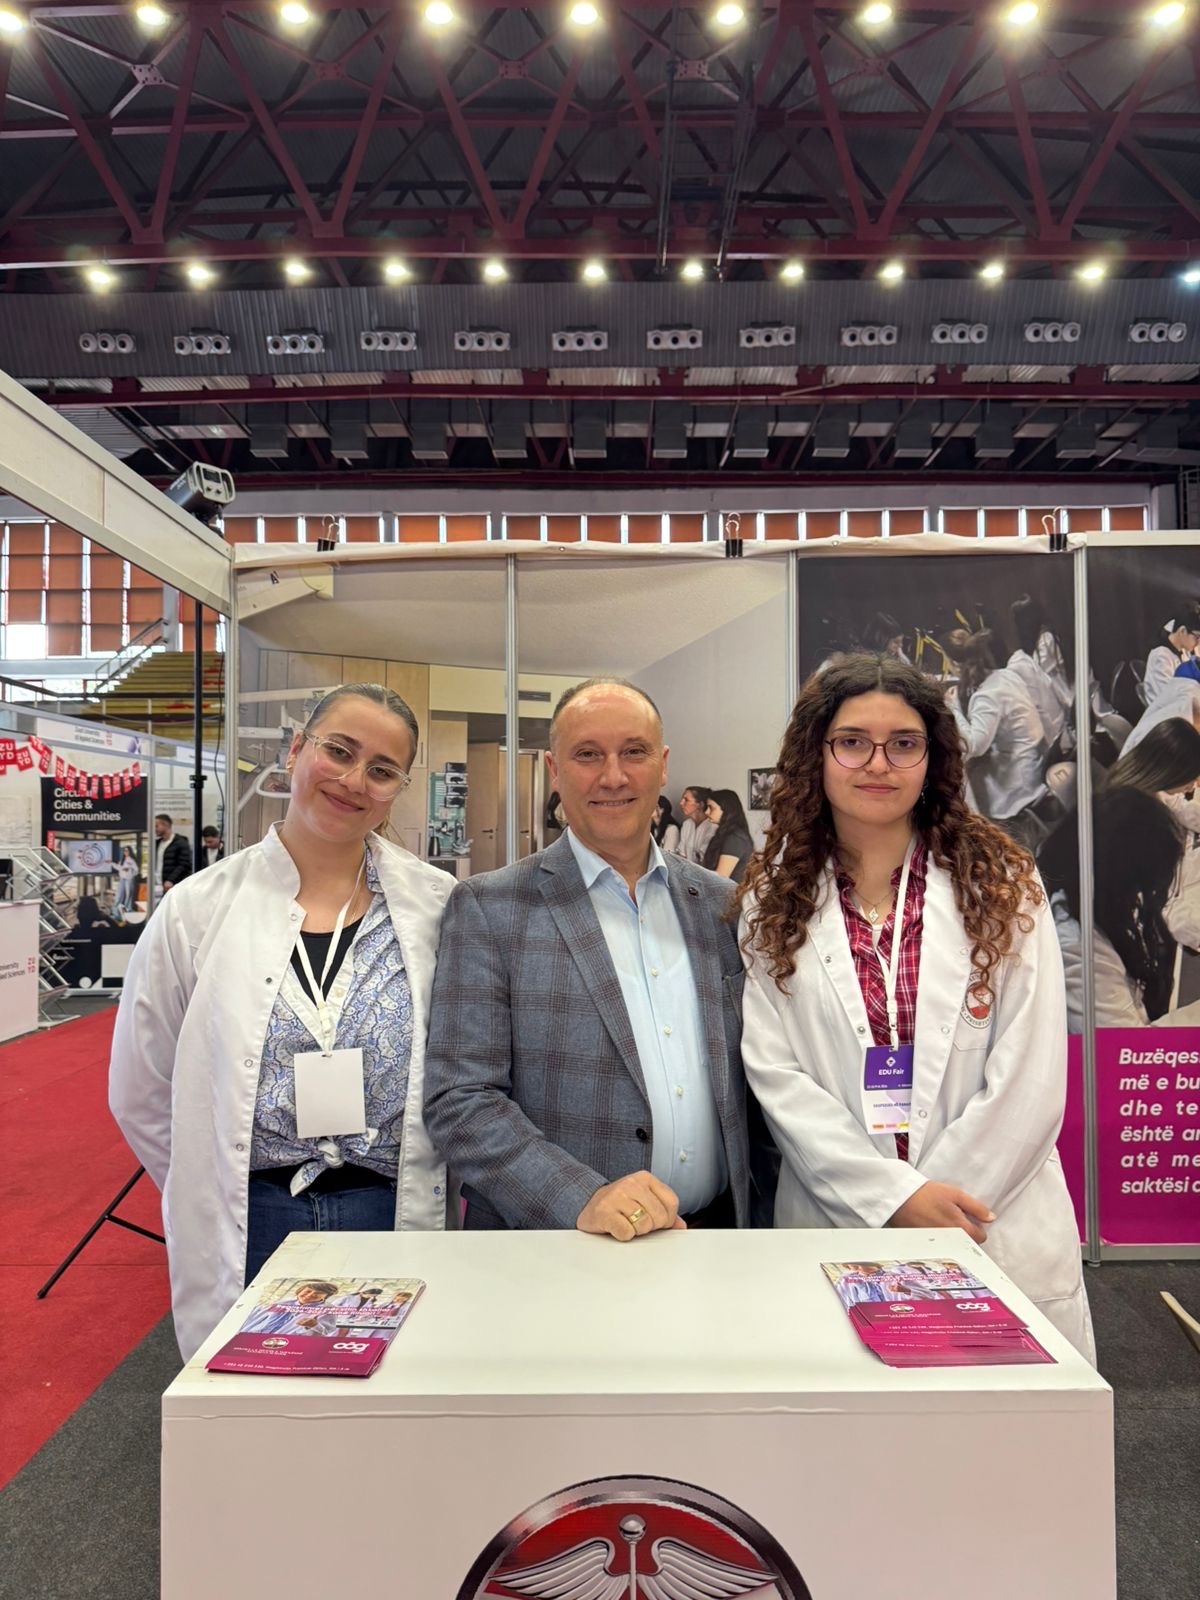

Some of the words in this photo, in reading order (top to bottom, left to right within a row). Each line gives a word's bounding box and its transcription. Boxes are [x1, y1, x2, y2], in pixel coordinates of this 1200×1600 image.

[54, 799, 83, 810] Cities
[84, 800, 93, 810] &
[53, 811, 122, 822] Communities
[1119, 1048, 1200, 1068] Buzëqes
[1119, 1074, 1150, 1091] më
[1156, 1077, 1169, 1090] e
[1120, 1099, 1163, 1117] dhe
[1176, 1101, 1199, 1116] te
[1120, 1125, 1175, 1142] është
[1120, 1151, 1160, 1168] atë
[1171, 1154, 1200, 1168] me
[1121, 1176, 1190, 1194] saktësi
